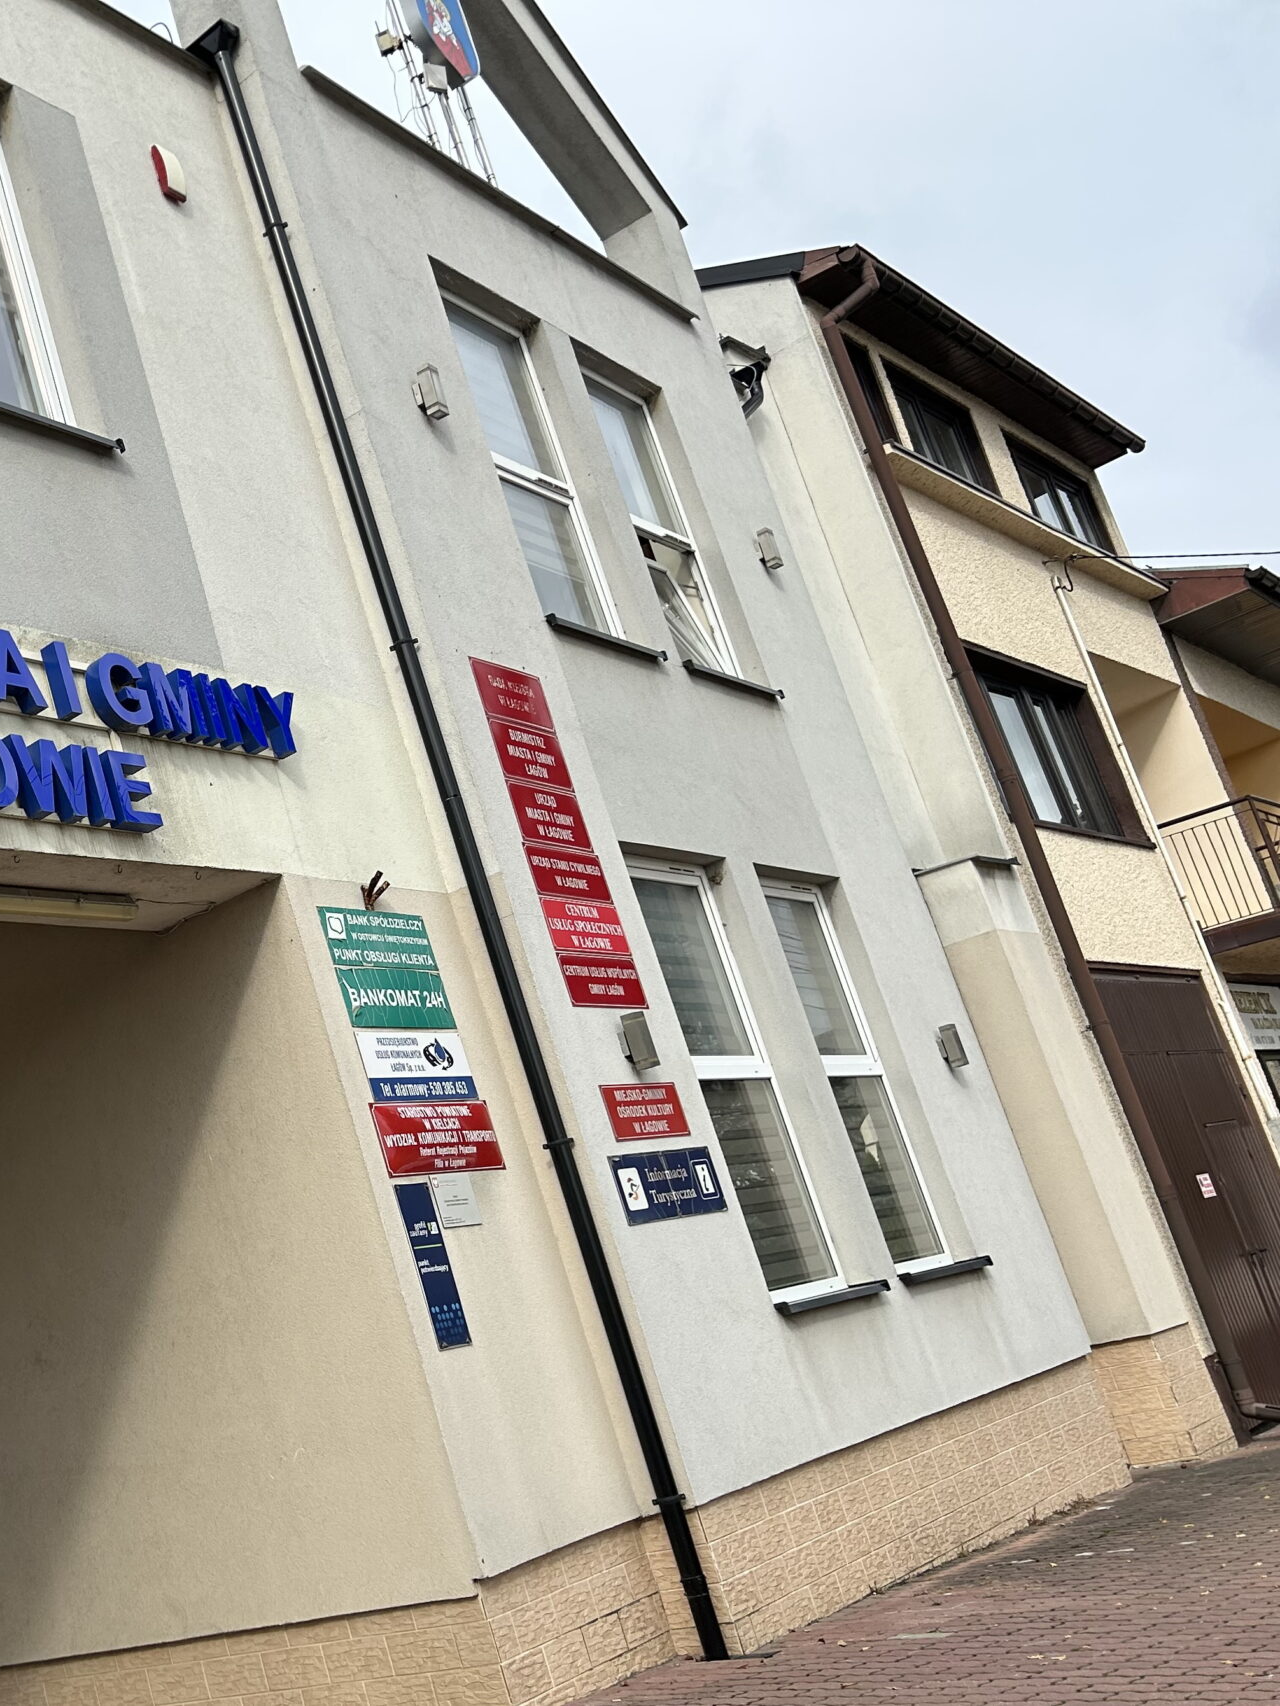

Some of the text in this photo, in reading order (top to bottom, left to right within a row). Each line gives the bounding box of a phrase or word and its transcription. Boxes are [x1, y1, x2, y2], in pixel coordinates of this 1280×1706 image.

[40, 641, 82, 721] I
[86, 652, 296, 759] GMINY
[508, 729, 546, 748] BURMISTRZ
[507, 744, 532, 759] MIASTA
[536, 752, 556, 766] GMINY
[525, 762, 549, 779] ŁAGÓW
[534, 793, 557, 809] URZĄD
[525, 806, 550, 821] MIASTA
[554, 812, 575, 827] GMINY
[537, 824, 575, 842] W ŁAGOWIE
[531, 855, 601, 877] URZĄD STANU CYWILNEGO
[554, 875, 590, 891] W ŁAGOWIE
[565, 904, 599, 919] CENTRUM
[346, 914, 422, 930] BANK SPÓŁDZIELCZY
[548, 919, 624, 936] USŁUG SPOŁECZNYCH
[571, 935, 613, 950] W ŁAGOWIE
[333, 948, 434, 966] PUNKT OBSŁUGI KLIENTA
[563, 964, 637, 980] CENTRUM USŁUG WSPÓLNYCH
[588, 982, 624, 995] GMINY ŁAGÓW
[348, 988, 446, 1008] BANKOMAT 24H
[380, 1082, 395, 1097] Tel.
[394, 1082, 430, 1097] alarmowy:
[614, 1088, 667, 1102] MIEJSKO-GMINNY
[397, 1106, 437, 1118] STAROSTWO
[617, 1103, 674, 1118] OŚRODEK KULTURY
[422, 1118, 461, 1130] W KIELCACH
[633, 1120, 670, 1133] W ŁAGOWIE
[384, 1133, 417, 1148] WYDZIAŁ
[417, 1131, 459, 1144] KOMUNIKACJI
[644, 1164, 688, 1182] Informacja
[649, 1188, 697, 1206] Turystyczna
